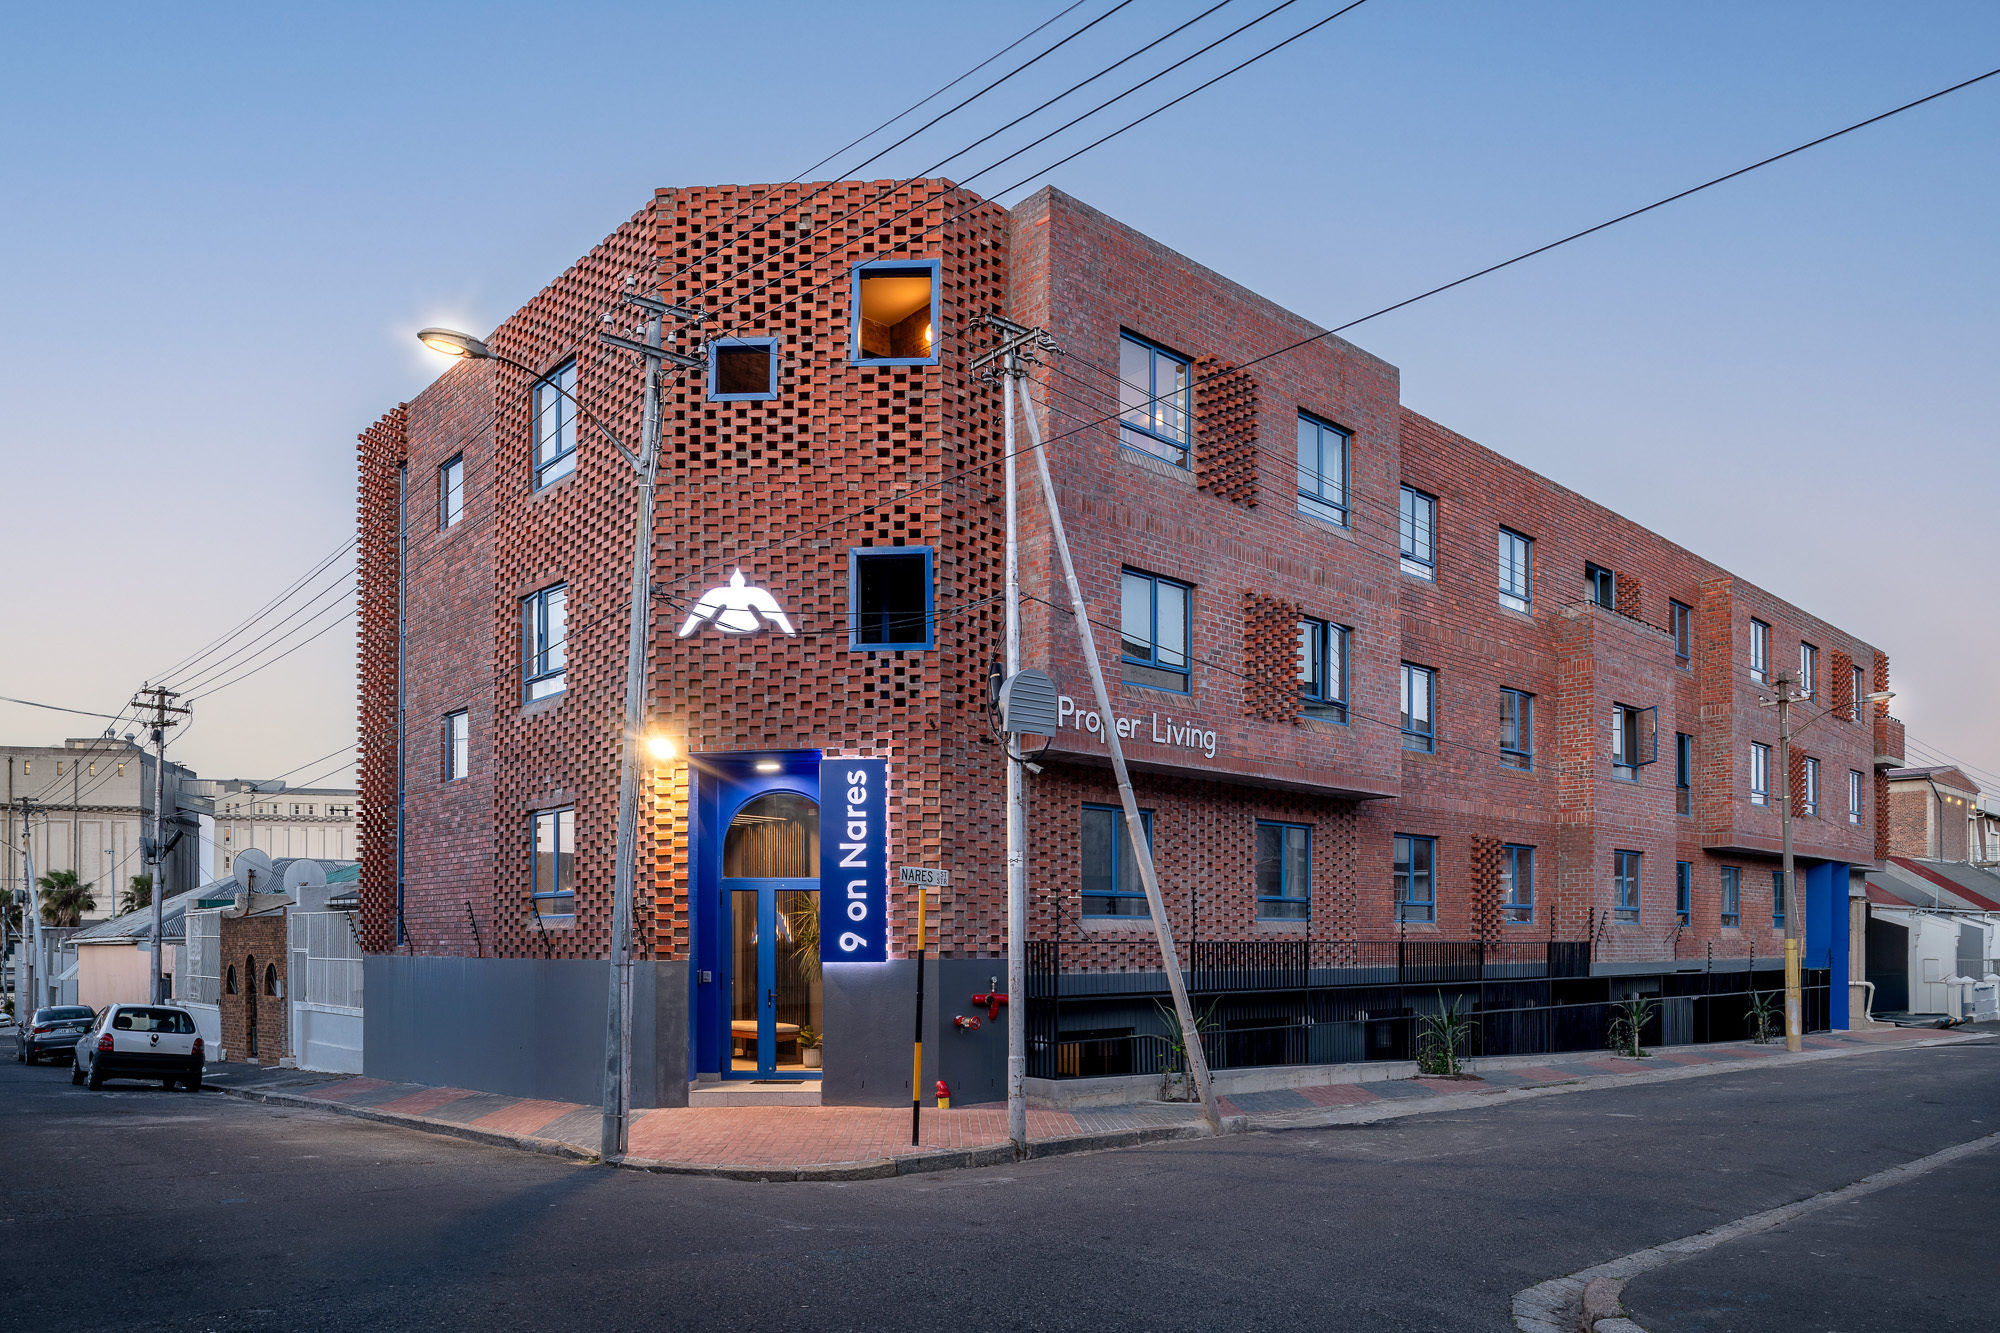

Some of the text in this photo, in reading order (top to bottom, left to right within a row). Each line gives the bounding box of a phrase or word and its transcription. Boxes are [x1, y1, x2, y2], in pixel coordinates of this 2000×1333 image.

[1152, 713, 1217, 759] Living
[839, 769, 867, 952] 9 on Nares
[901, 868, 934, 883] NARES
